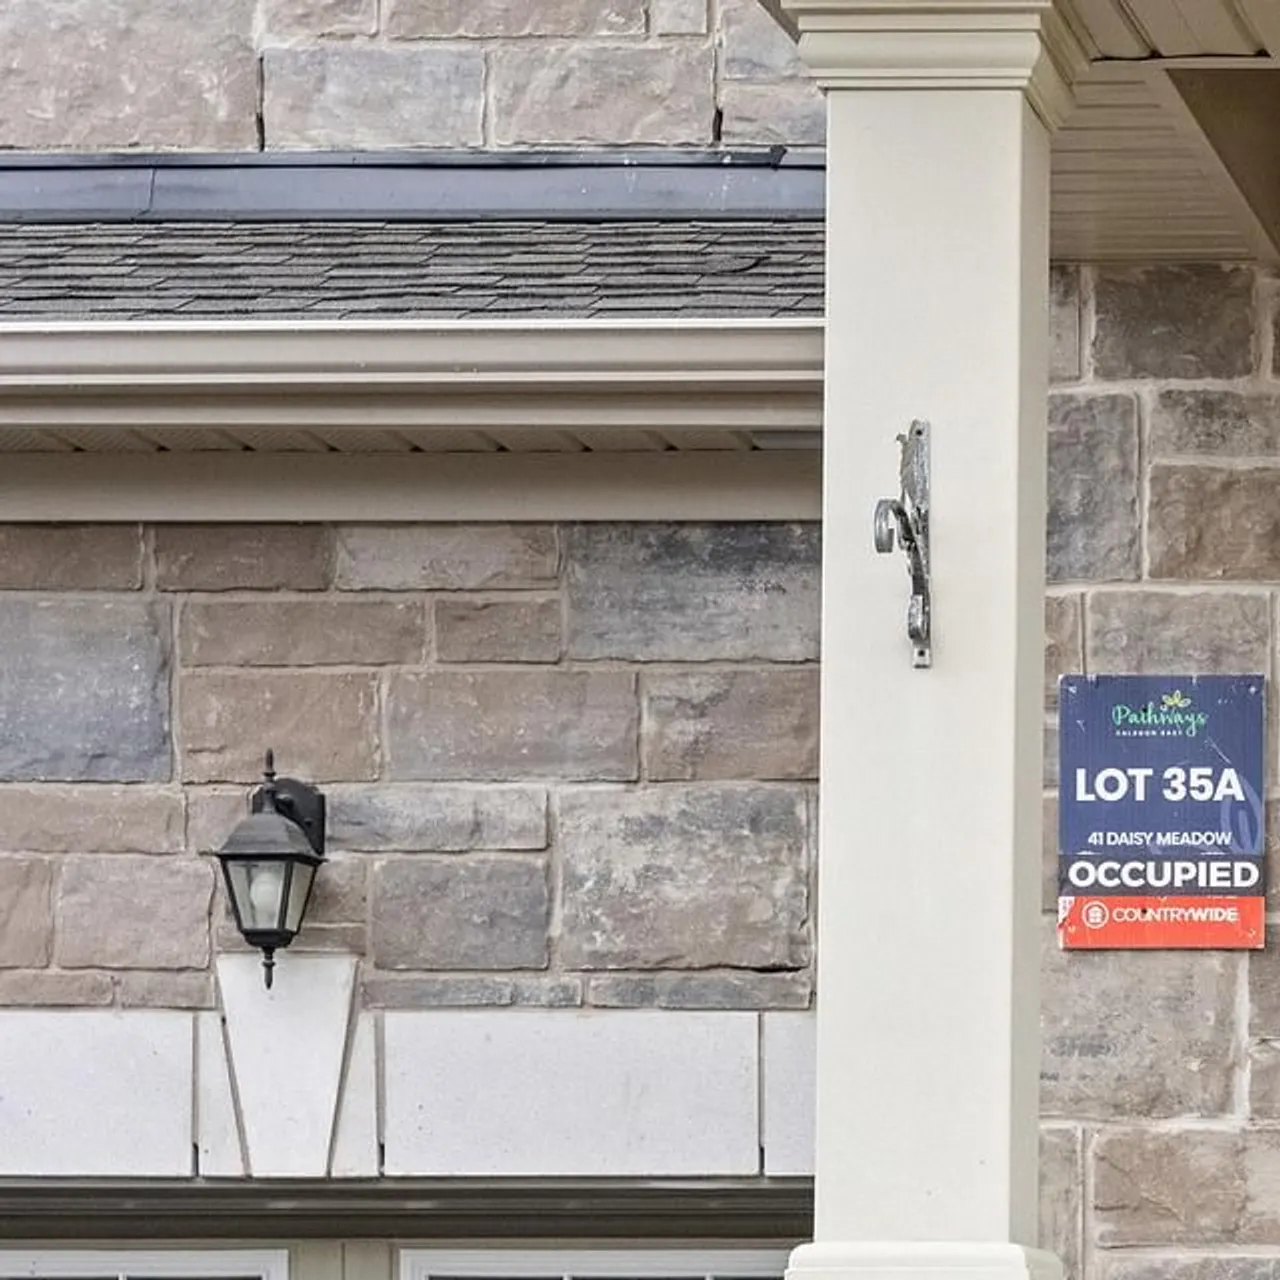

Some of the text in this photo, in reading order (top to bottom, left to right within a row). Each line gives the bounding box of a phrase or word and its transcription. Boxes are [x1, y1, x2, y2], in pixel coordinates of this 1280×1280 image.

[1111, 701, 1208, 737] Pathways
[1075, 768, 1245, 802] LOT 35A
[1087, 831, 1232, 846] 41 DAISY MEADOW
[1068, 861, 1259, 888] OCCUPIED
[1112, 907, 1239, 922] COUNTRYWIDE
